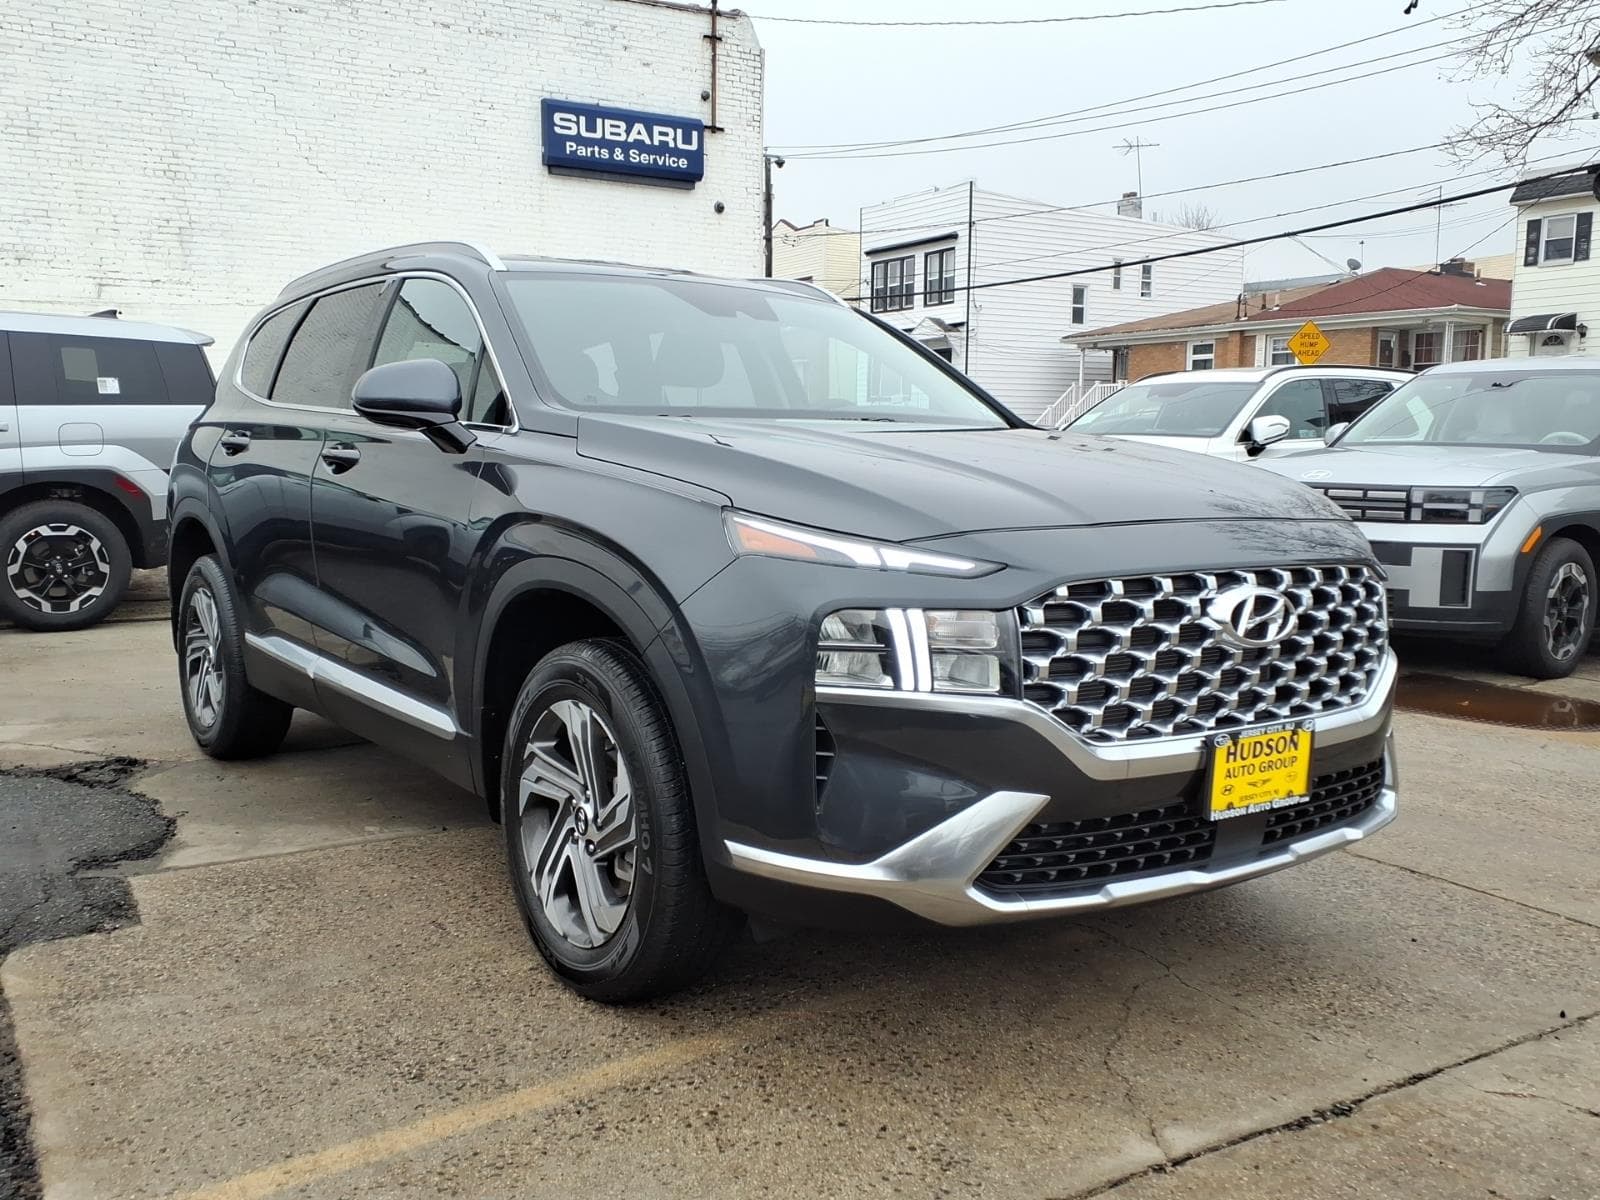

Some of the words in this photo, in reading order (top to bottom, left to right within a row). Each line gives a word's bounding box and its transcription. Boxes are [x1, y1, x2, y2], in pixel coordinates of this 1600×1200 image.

[553, 112, 698, 150] SUBARU
[566, 142, 609, 159] Parts
[613, 148, 625, 161] &
[629, 150, 688, 168] Service
[1299, 332, 1320, 340] SPEED
[1298, 349, 1320, 357] AHEAD
[1240, 727, 1266, 737] JERSEY
[1226, 735, 1299, 763] HUDSON
[1224, 764, 1256, 779] AUTO
[1259, 756, 1297, 773] GROUP
